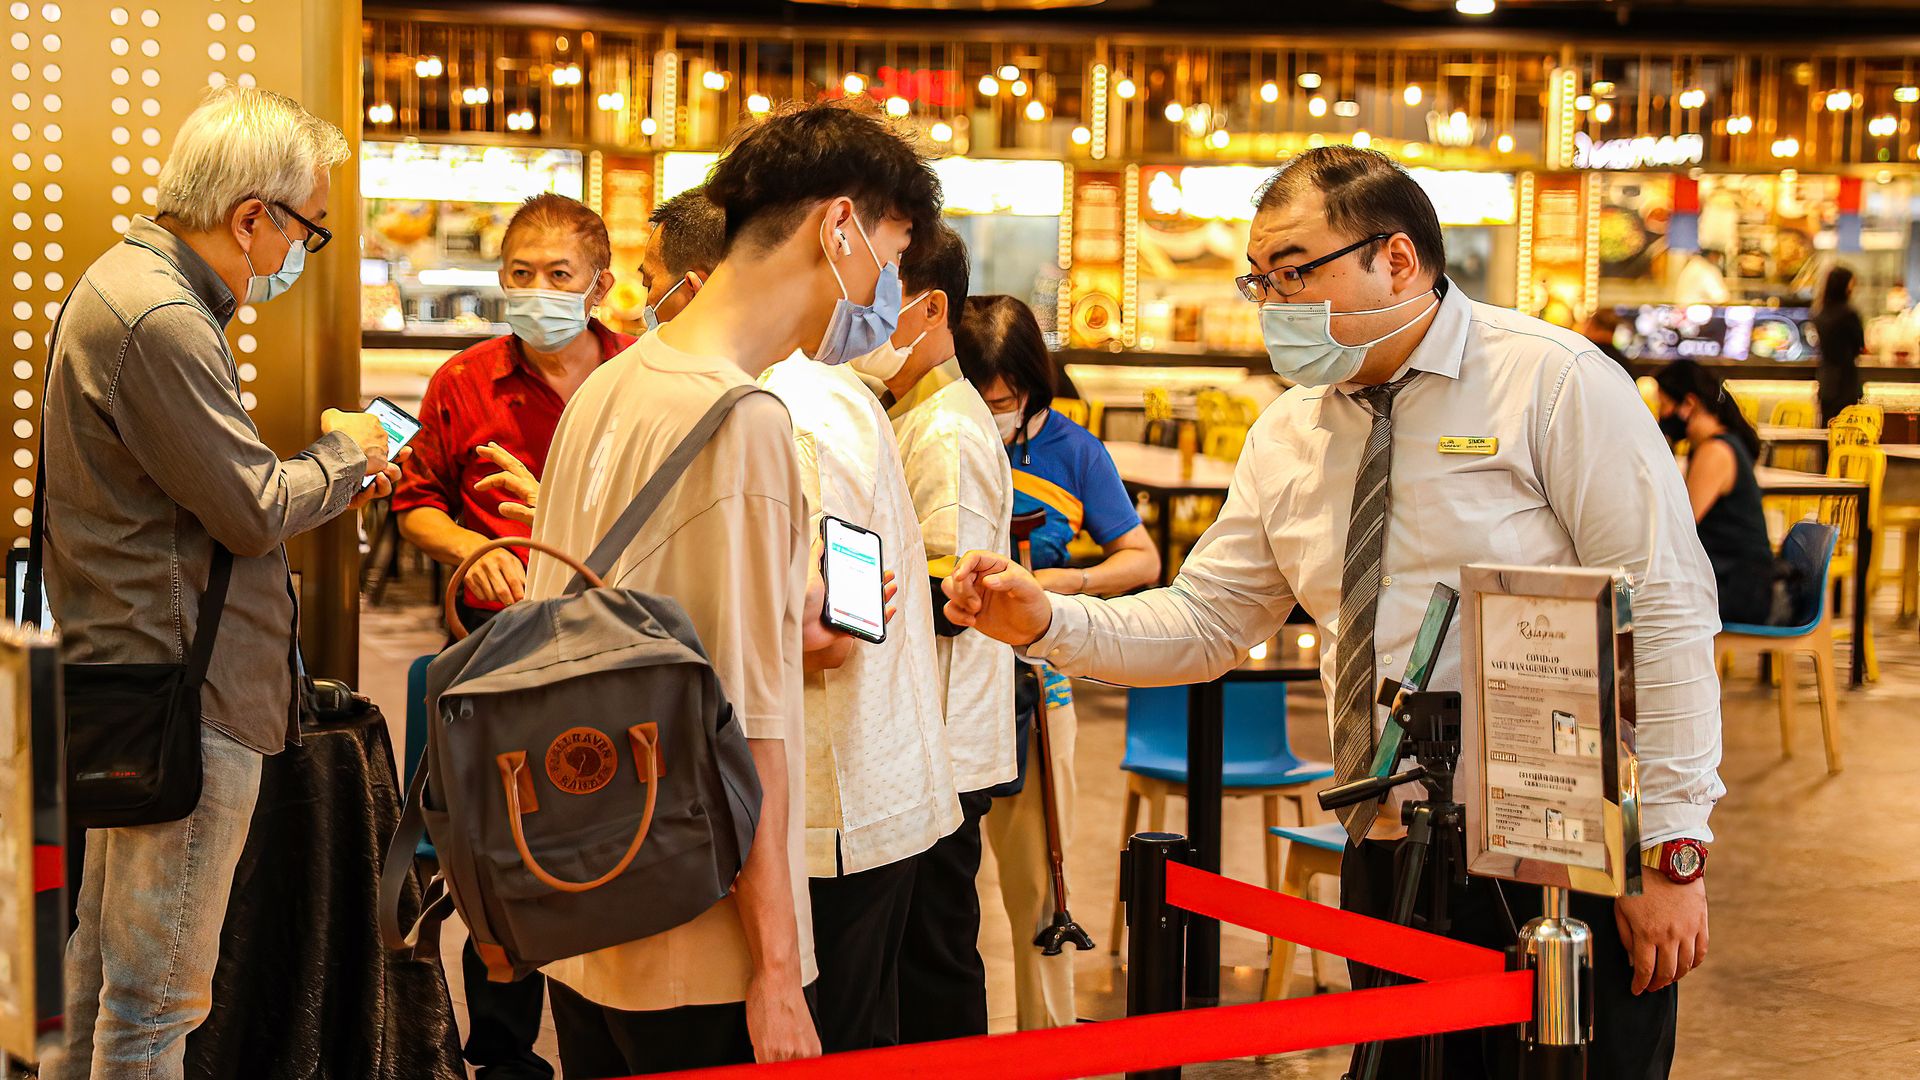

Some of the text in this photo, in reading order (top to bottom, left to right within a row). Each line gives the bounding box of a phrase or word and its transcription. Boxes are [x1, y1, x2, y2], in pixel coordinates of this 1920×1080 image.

[1526, 653, 1560, 664] COVID-19
[1491, 660, 1508, 670] SAFE
[1509, 661, 1558, 674] MANAGEMENT
[1560, 666, 1598, 678] MEASURES
